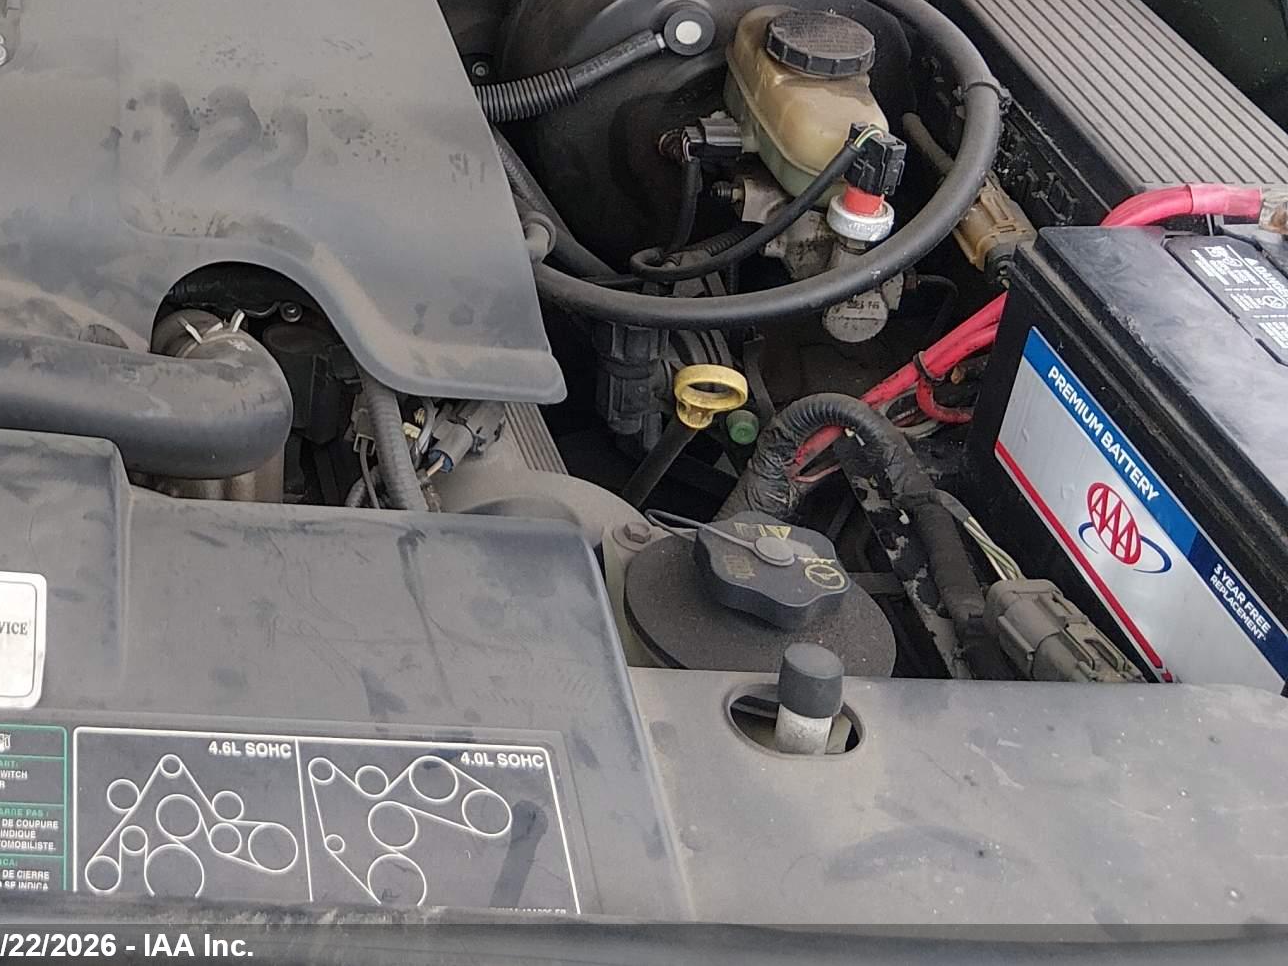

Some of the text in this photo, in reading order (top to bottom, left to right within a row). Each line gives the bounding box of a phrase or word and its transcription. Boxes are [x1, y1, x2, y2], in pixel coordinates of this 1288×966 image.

[1048, 366, 1160, 501] PREMIUM BATTERY
[1091, 487, 1136, 563] AAA
[1214, 564, 1271, 633] 3 YEAR FREE
[209, 741, 291, 760] 4.6L SOHC
[461, 751, 544, 770] 4.0L SOHC
[2, 818, 13, 826] DE
[16, 819, 59, 829] COUPURE
[2, 869, 13, 878] DE
[17, 870, 50, 880] CIERRE
